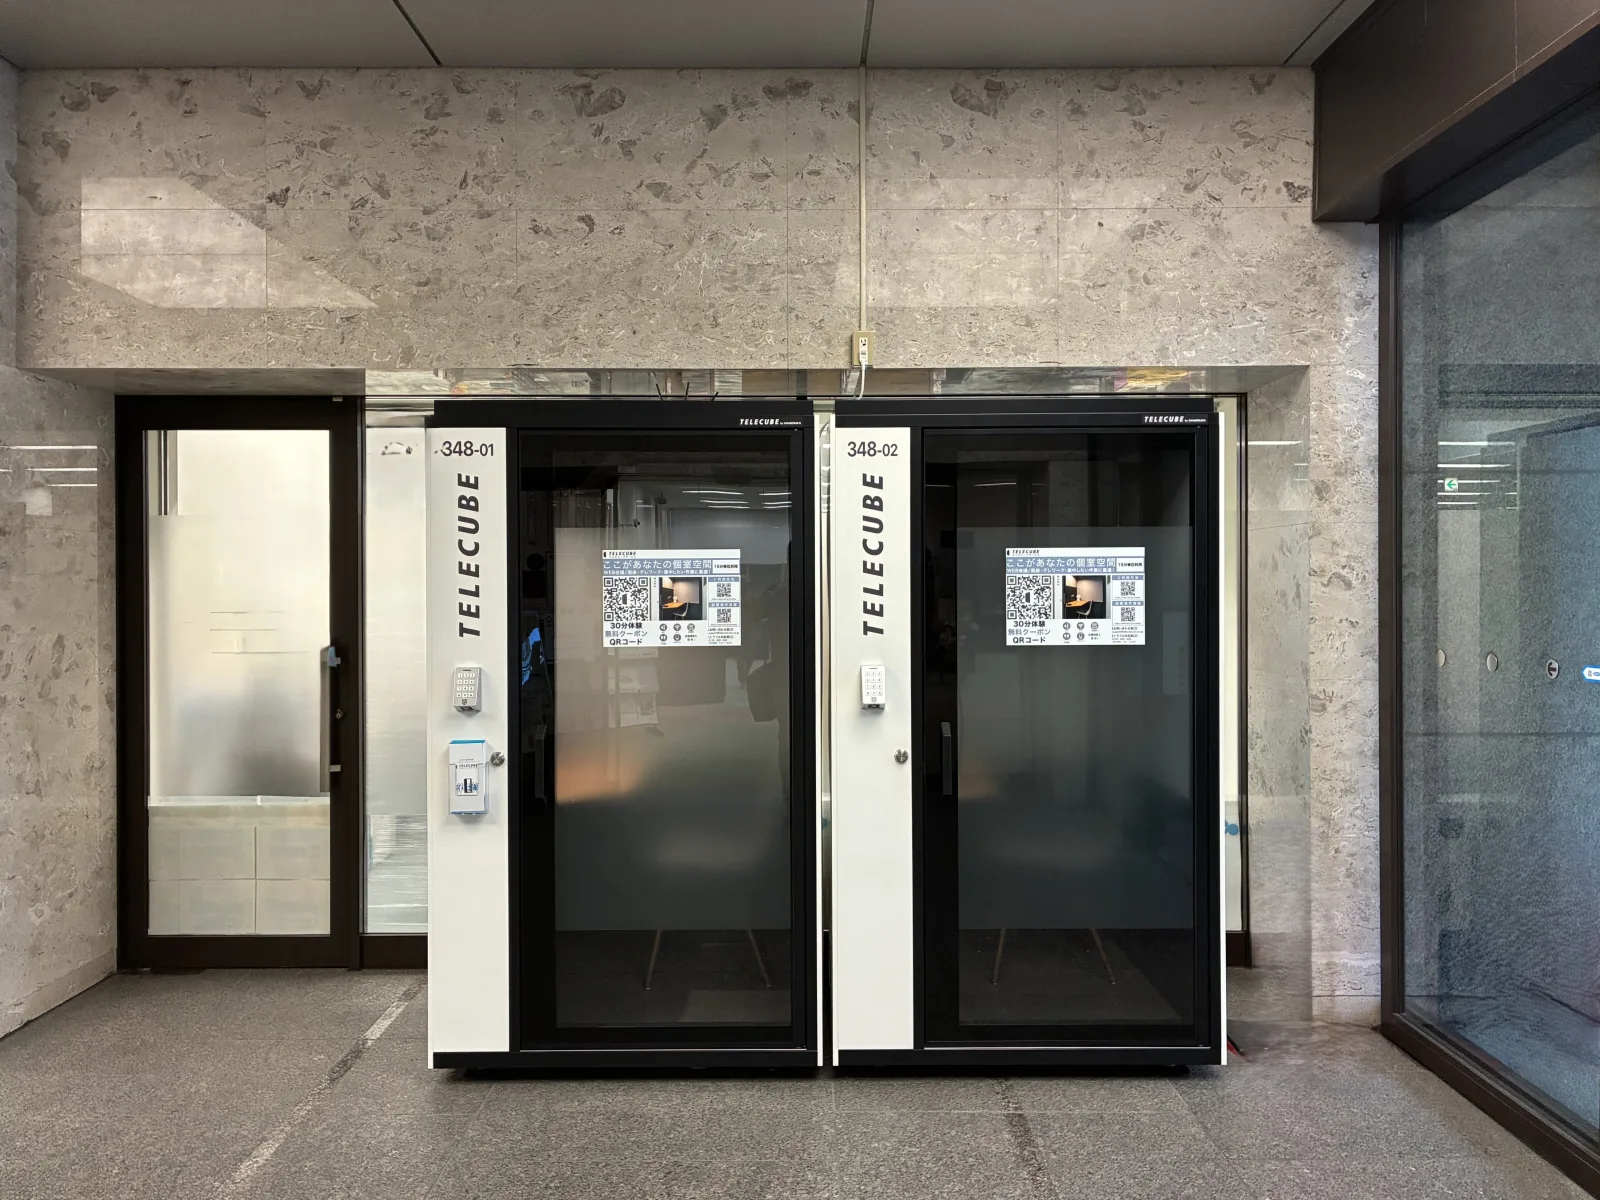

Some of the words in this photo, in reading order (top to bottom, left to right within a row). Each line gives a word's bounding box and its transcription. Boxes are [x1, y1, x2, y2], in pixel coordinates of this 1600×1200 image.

[740, 418, 780, 426] TELECUBE
[1144, 415, 1185, 423] TELECUBE
[442, 440, 494, 457] 348-01
[847, 440, 898, 457] 348-02
[457, 472, 481, 638] TELECUBE
[862, 472, 885, 636] TELECUBE
[603, 559, 712, 569] ここがあなたの個室空間
[1007, 558, 1116, 568] ここがあなたの個室空間
[610, 622, 643, 630] 30分体験
[604, 630, 648, 638] 無料クーポン
[1007, 628, 1051, 636] 無料クーポン
[609, 638, 643, 646] QRコード
